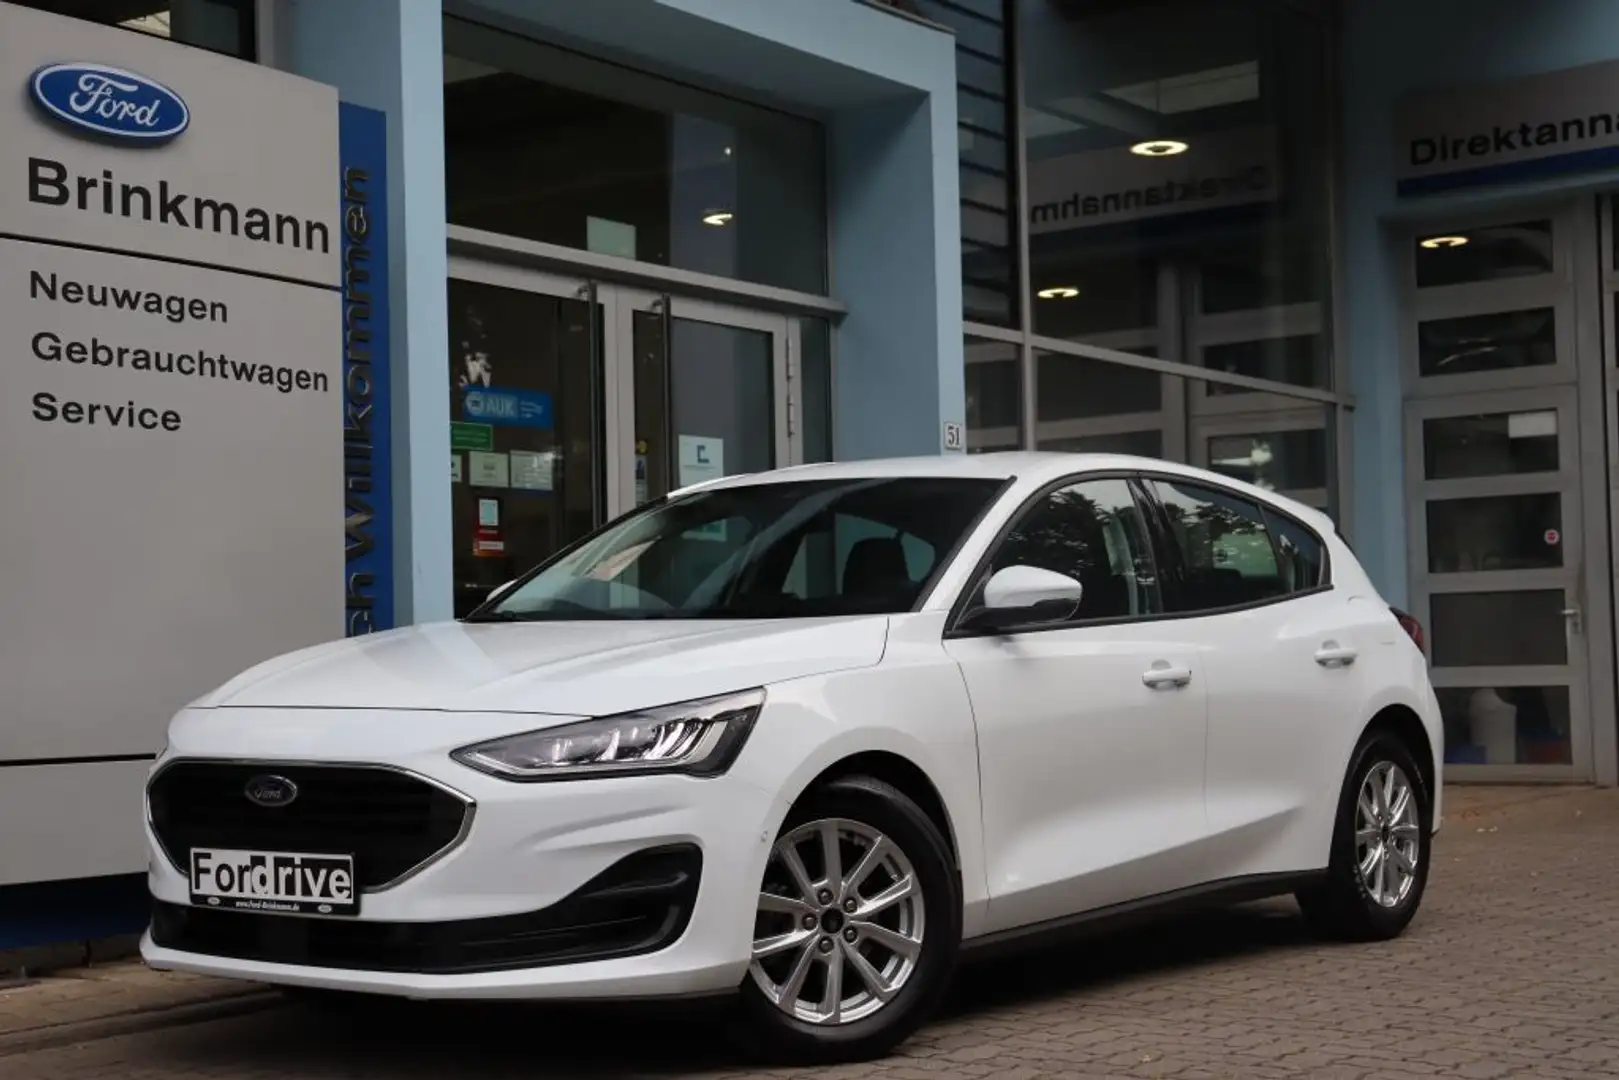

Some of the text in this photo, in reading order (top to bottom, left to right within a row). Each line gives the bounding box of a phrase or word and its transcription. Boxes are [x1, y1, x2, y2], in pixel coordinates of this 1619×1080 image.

[69, 73, 161, 128] Ford
[1410, 112, 1619, 166] Direktann
[28, 156, 330, 254] Brinkmann
[29, 270, 228, 323] Neuwagen
[31, 332, 329, 393] Gebrauchtwagen
[344, 165, 375, 562] Willkommen
[31, 392, 182, 431] Service
[947, 425, 960, 446] 51
[192, 852, 352, 900] Fordrive
